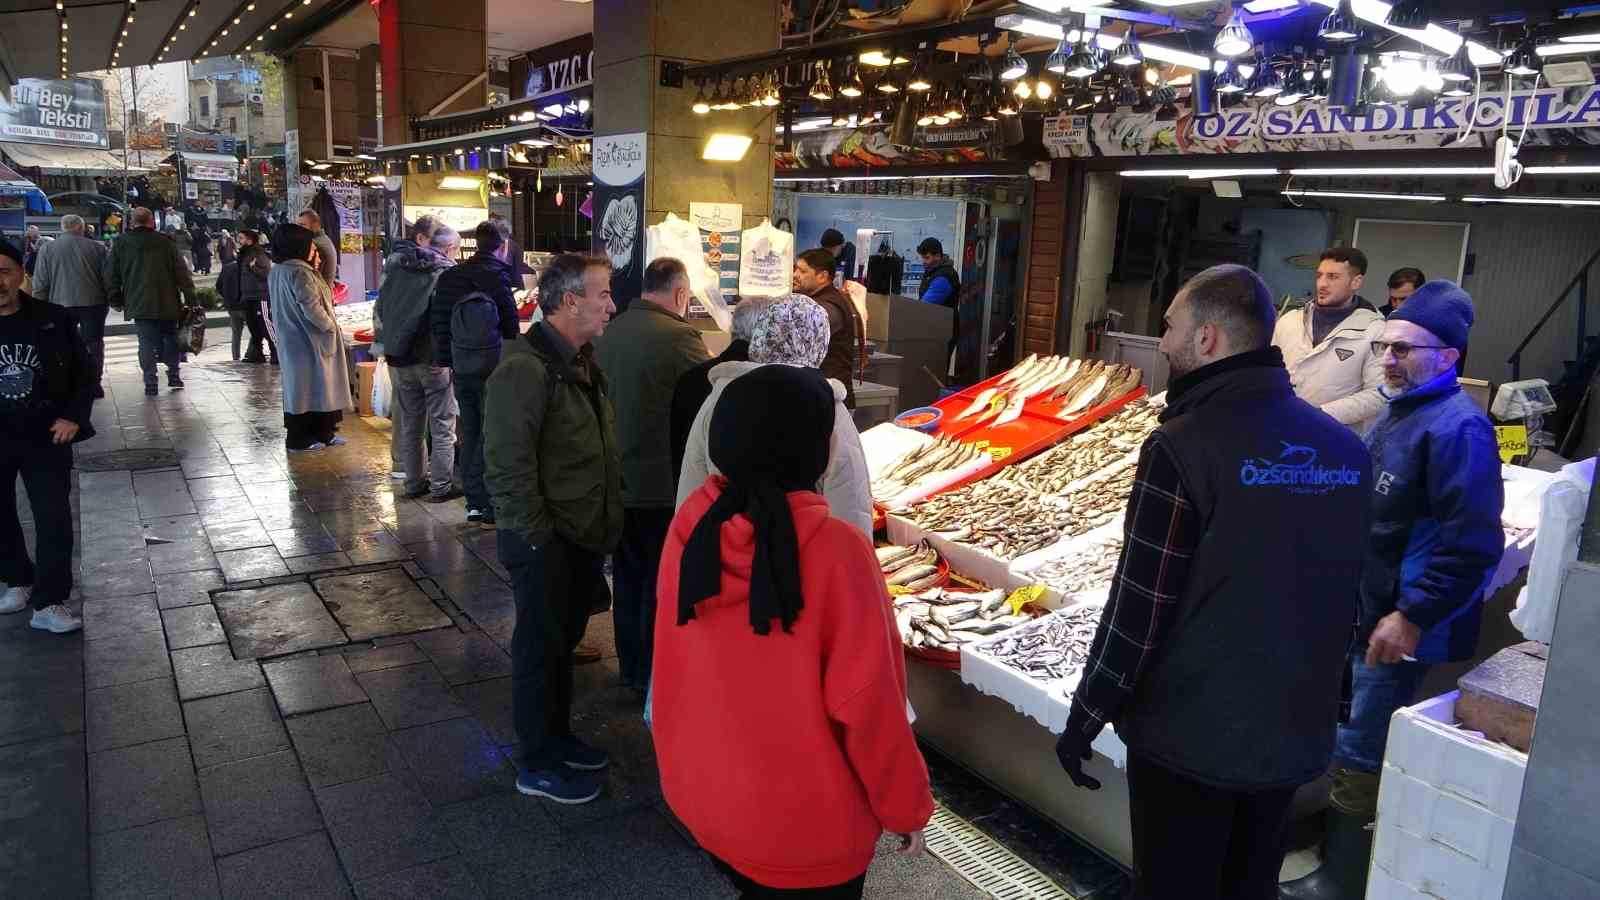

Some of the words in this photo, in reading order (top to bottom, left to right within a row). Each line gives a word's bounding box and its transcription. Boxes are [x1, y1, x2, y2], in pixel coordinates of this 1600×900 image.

[548, 55, 581, 90] YZC
[39, 87, 73, 112] Bey
[38, 107, 92, 128] Tekstil
